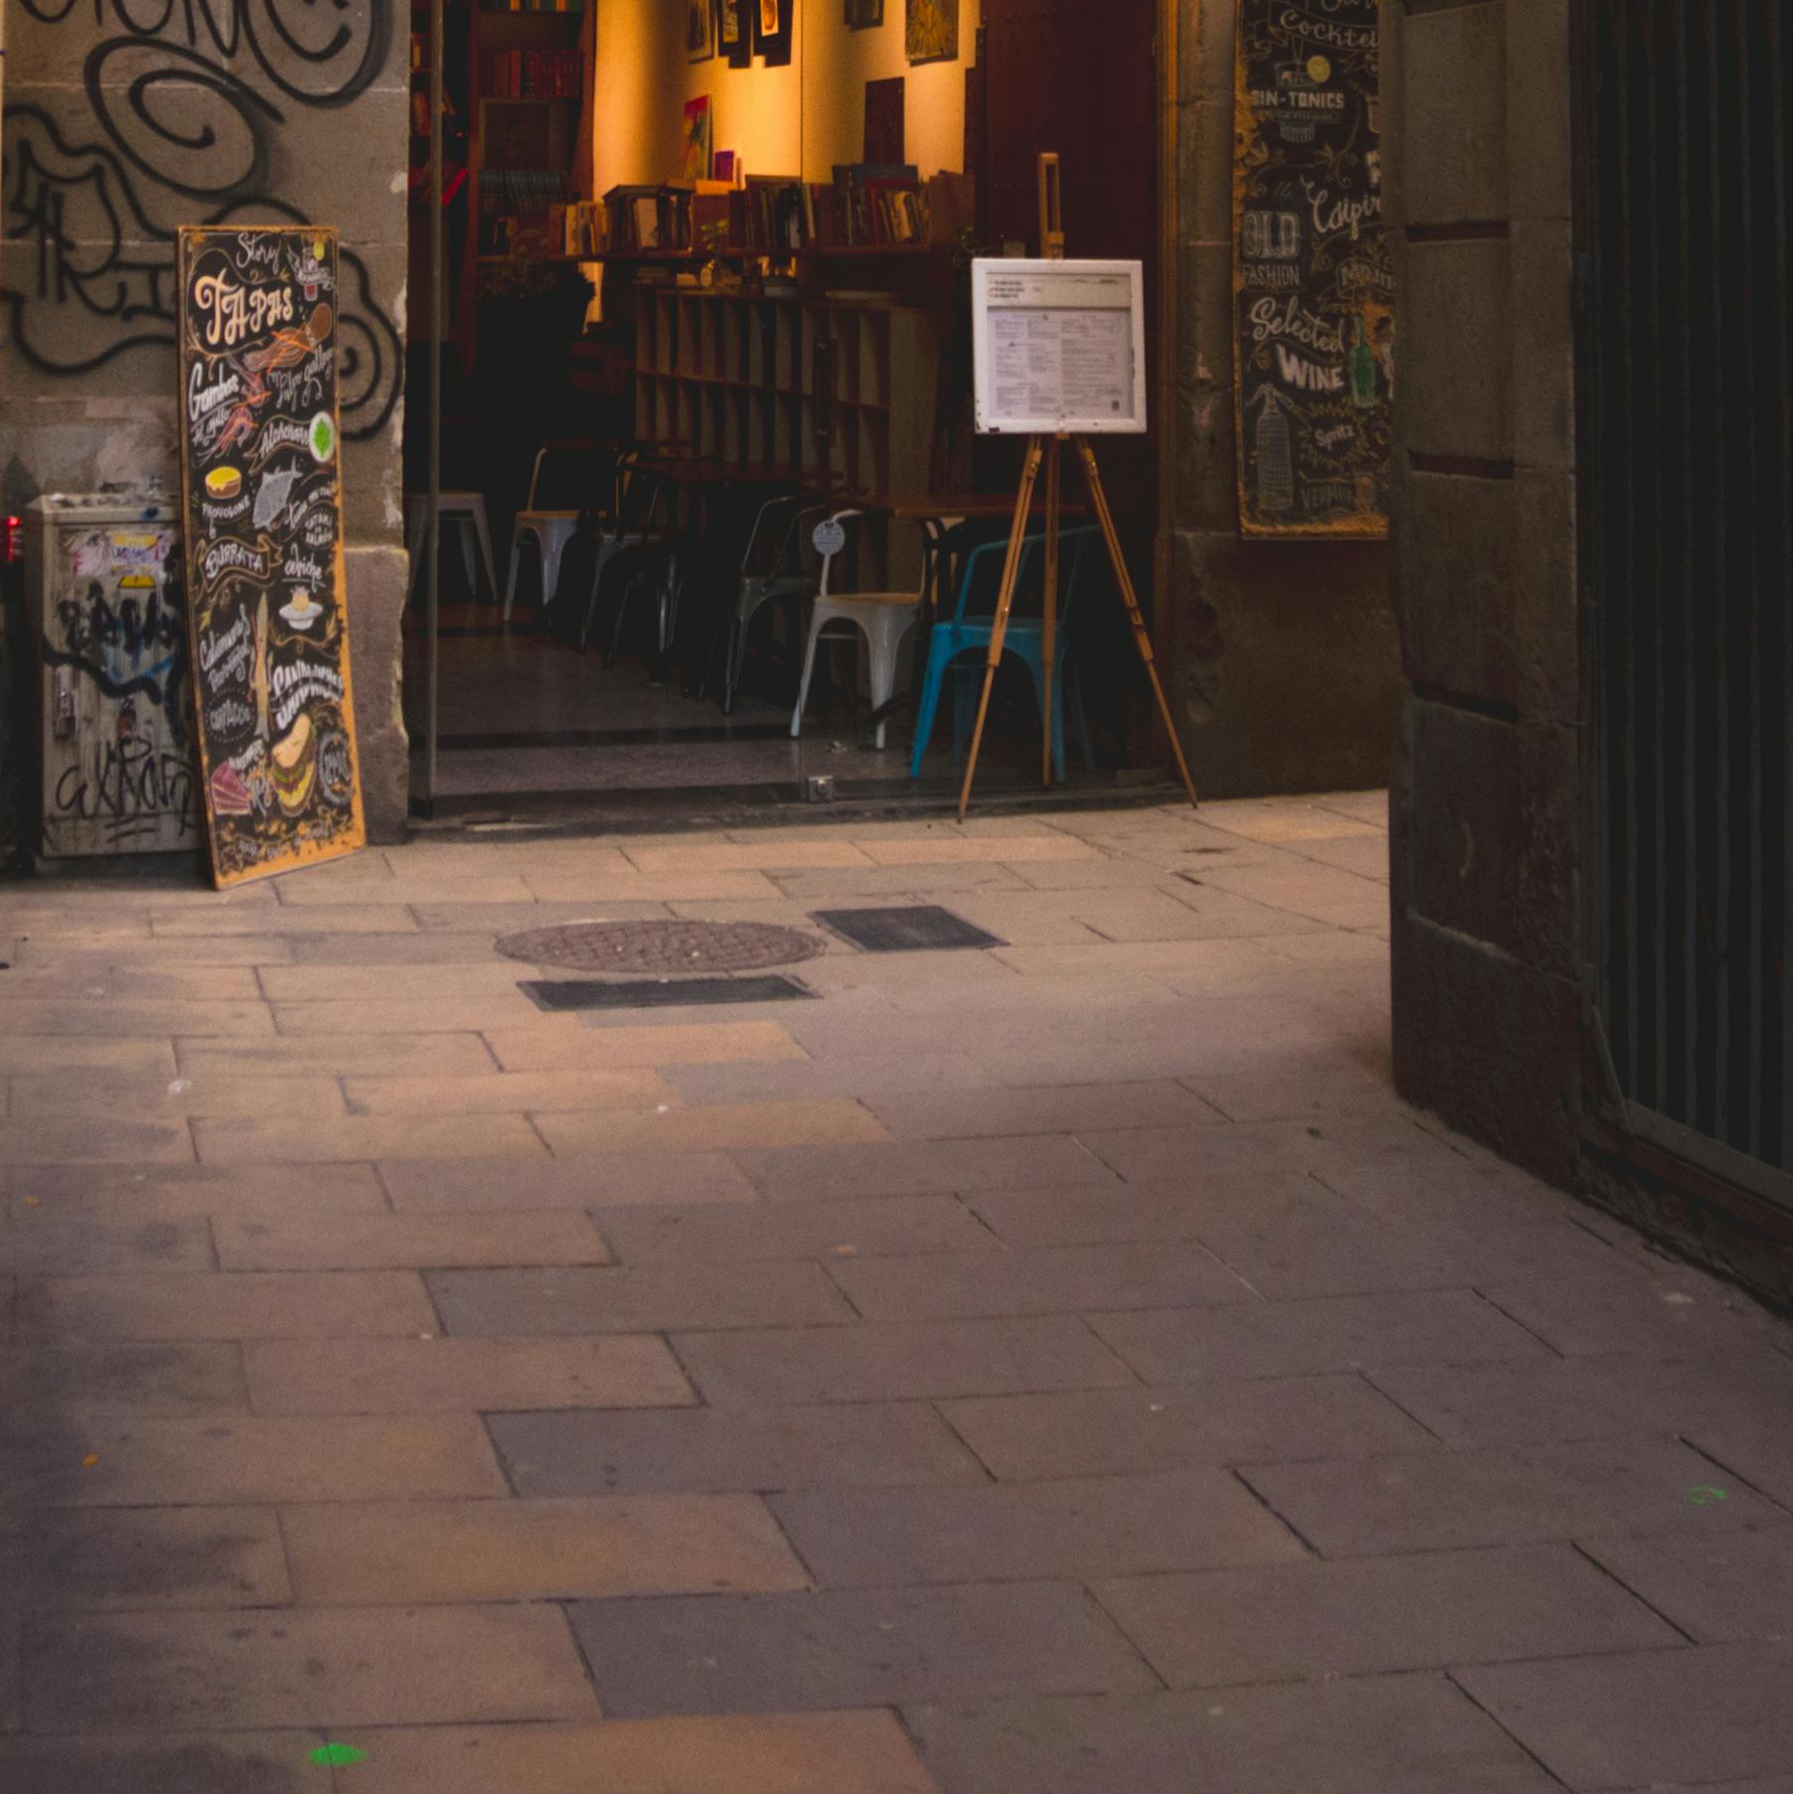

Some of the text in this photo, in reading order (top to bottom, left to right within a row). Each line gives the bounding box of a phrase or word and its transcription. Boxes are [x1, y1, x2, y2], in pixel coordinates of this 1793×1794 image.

[236, 231, 282, 275] Story
[1242, 209, 1301, 259] OLD
[1242, 264, 1300, 287] FASHION
[194, 267, 294, 346] TAPAS
[1250, 295, 1346, 353] Selected
[1275, 342, 1346, 392] WINE
[206, 542, 264, 580] BURRATA
